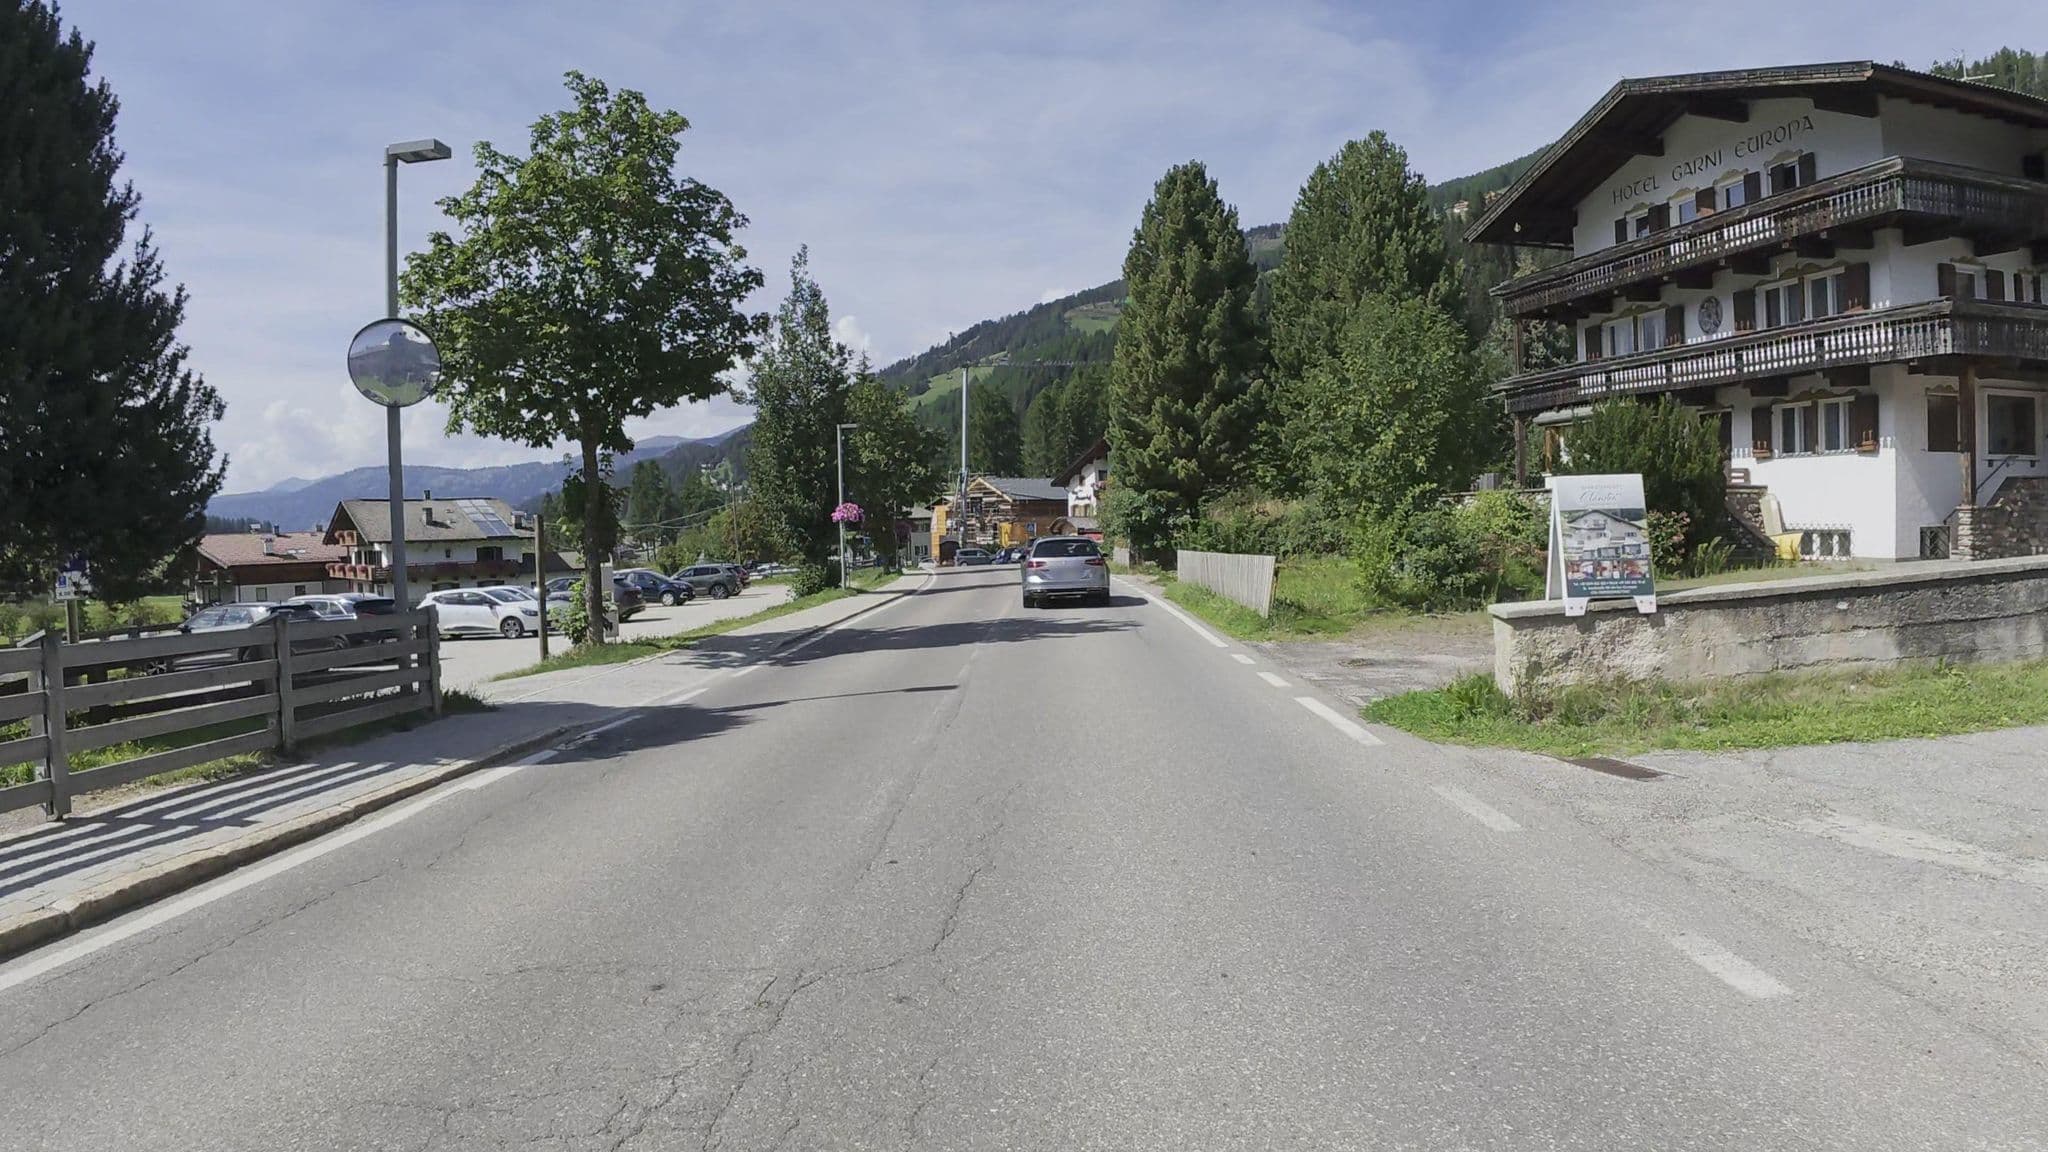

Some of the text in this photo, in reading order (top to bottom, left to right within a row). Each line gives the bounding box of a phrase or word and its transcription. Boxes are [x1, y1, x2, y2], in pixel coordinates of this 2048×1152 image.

[1612, 115, 1815, 205] HOTEL GARNI EUROPA
